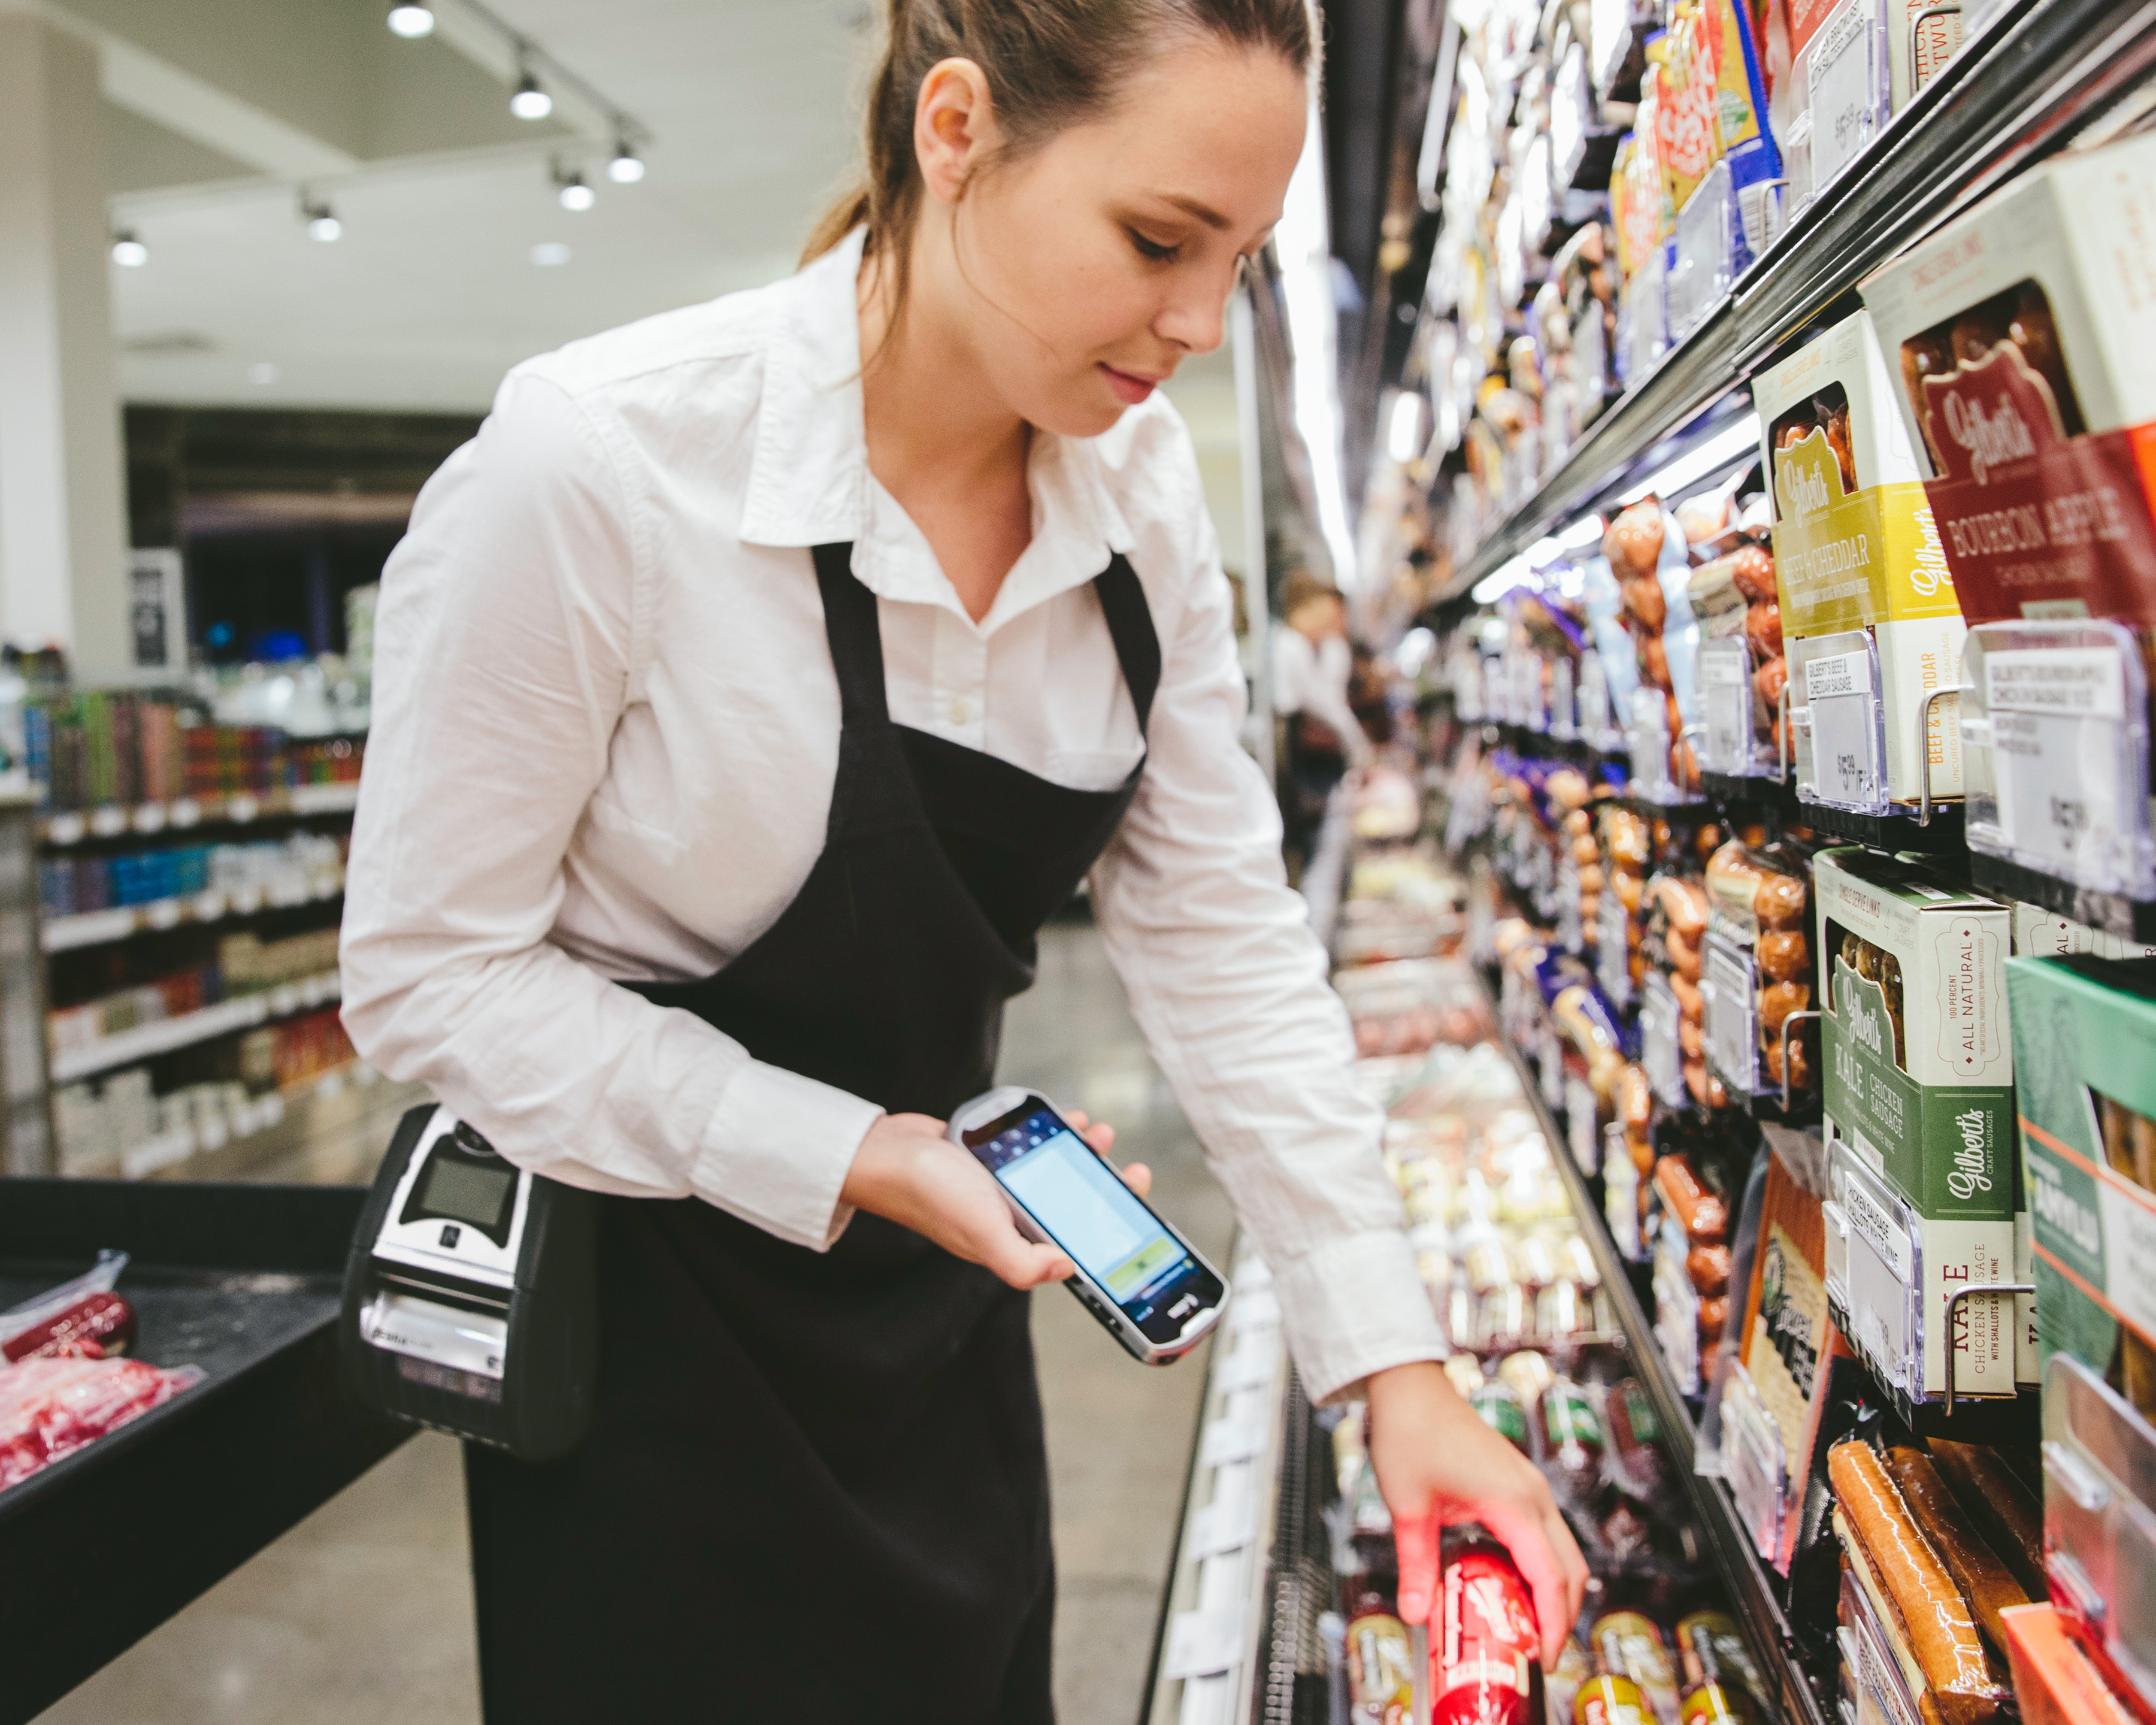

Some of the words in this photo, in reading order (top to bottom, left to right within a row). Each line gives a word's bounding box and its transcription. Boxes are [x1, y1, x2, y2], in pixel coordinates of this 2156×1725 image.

[1812, 534, 1870, 578] CHEDDAR
[1941, 631, 1951, 672] SAUSAGE
[1921, 652, 1940, 715] CHDDAR
[1927, 718, 1942, 728] &
[1948, 716, 1957, 738] BEEF
[1927, 733, 1944, 764] BEEF
[1948, 739, 1961, 783] UNCURED
[1949, 974, 1957, 1006] PERCENT
[1963, 1022, 1975, 1050] ALL
[1834, 1042, 1864, 1100] KALE
[1869, 1073, 1903, 1117] CHICKEN
[1870, 1094, 1904, 1139] SAUSAGE
[1947, 1107, 1993, 1200] Gilbert's
[1867, 1203, 1889, 1239] SAUSAGE
[1990, 1258, 1999, 1275] WINE
[1991, 1276, 1999, 1299] WTE
[1975, 1310, 1985, 1373] CHICKEN
[1991, 1306, 1999, 1342] SHALLOTS
[1991, 1343, 1999, 1361] WITH
